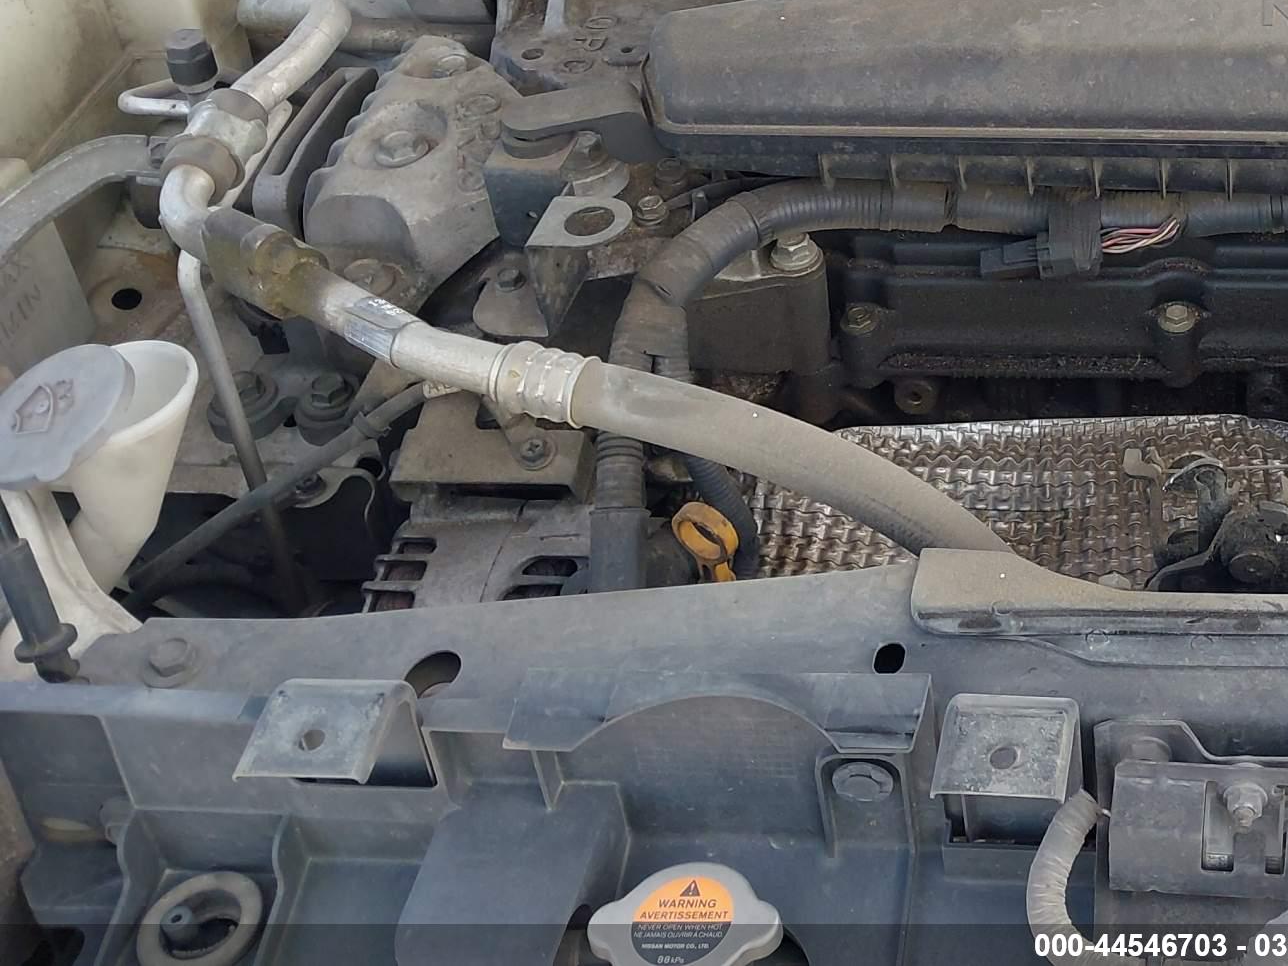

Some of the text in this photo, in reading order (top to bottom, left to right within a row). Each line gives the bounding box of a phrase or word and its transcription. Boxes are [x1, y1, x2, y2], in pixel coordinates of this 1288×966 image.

[658, 899, 717, 908] WARNING
[640, 911, 729, 920] AVERTISSEMENT
[633, 931, 642, 939] NE
[643, 931, 667, 939] JAMAIS
